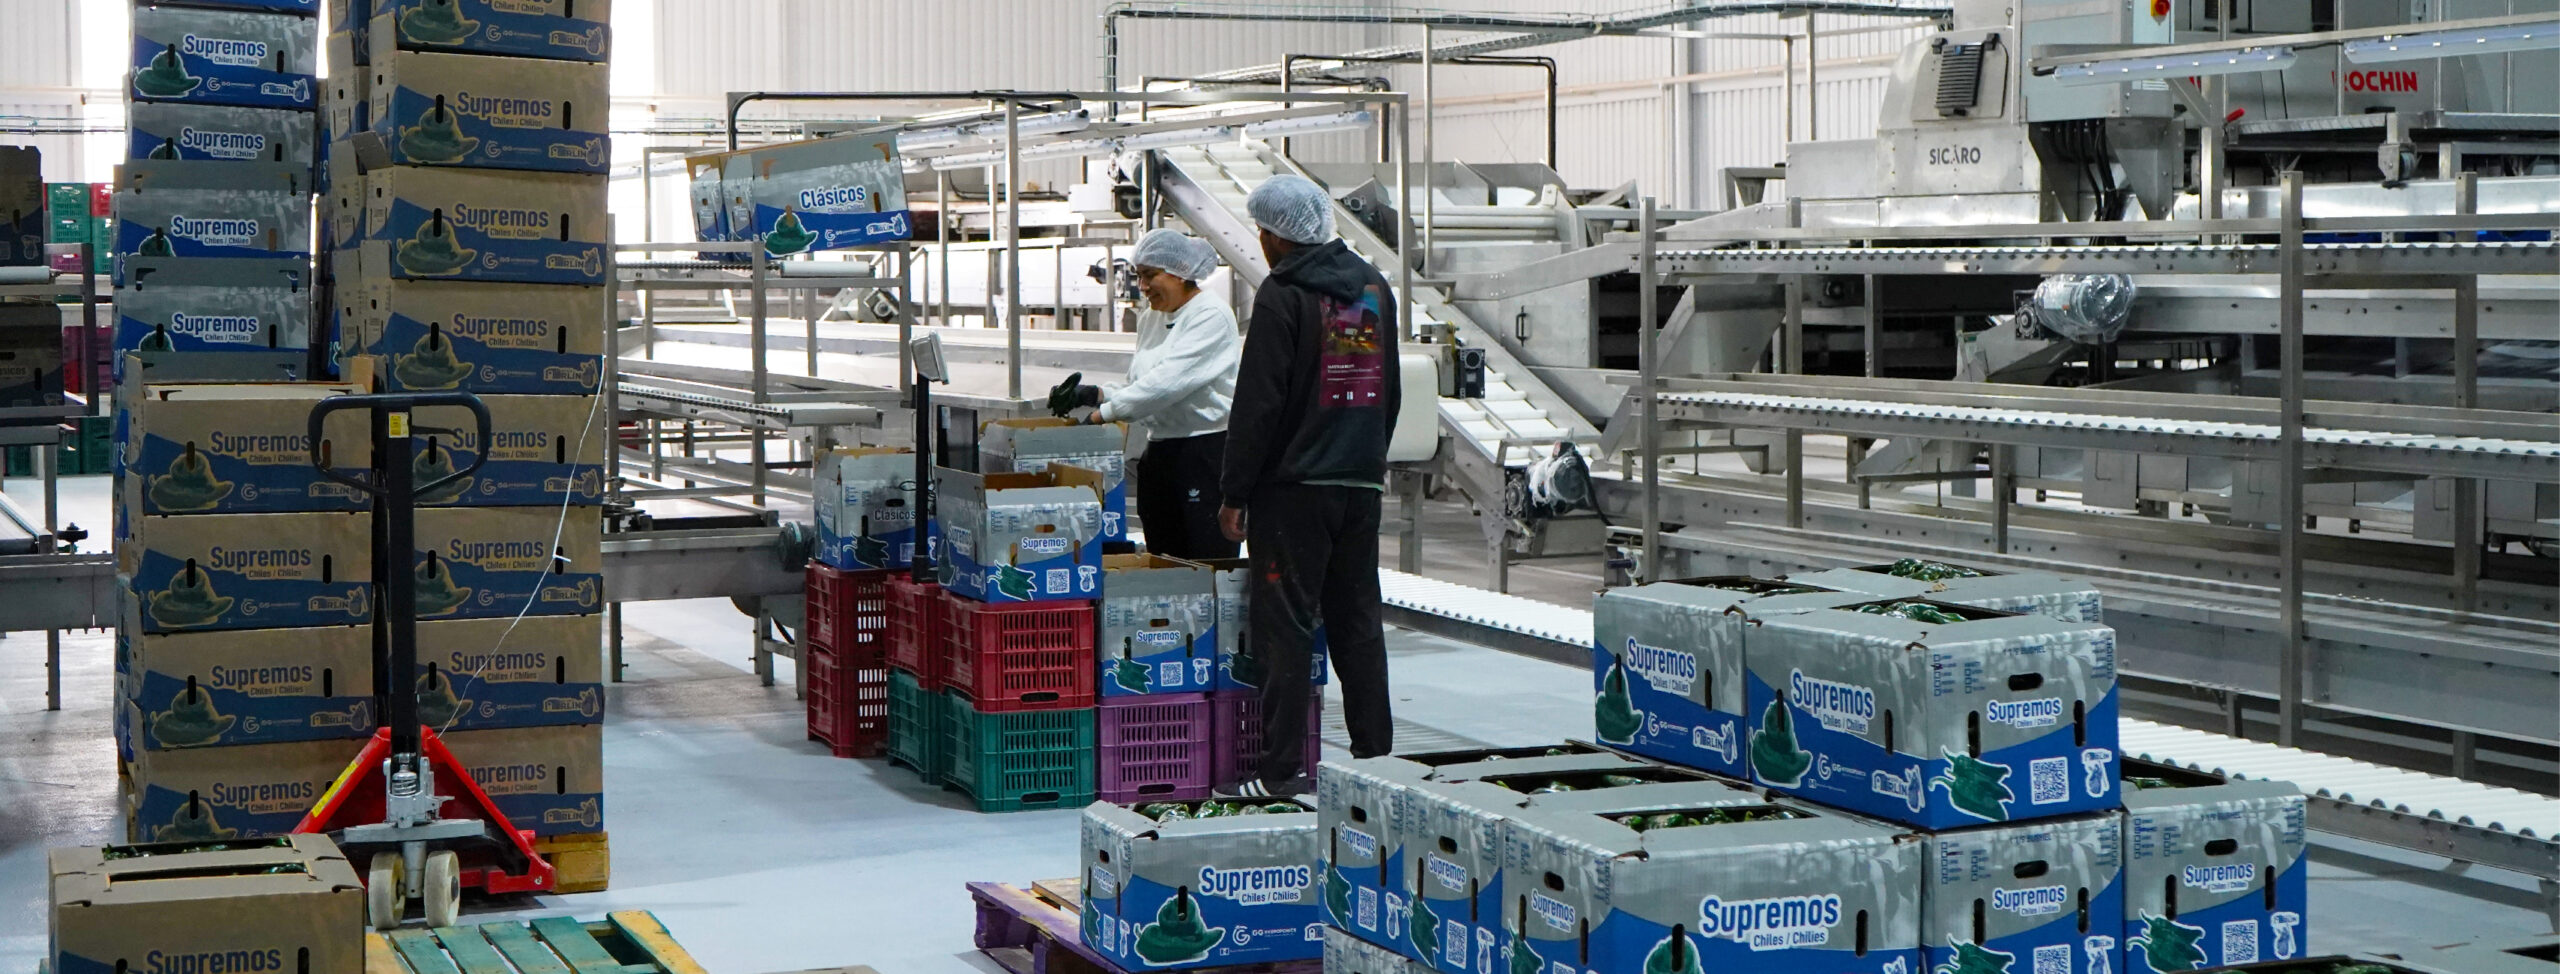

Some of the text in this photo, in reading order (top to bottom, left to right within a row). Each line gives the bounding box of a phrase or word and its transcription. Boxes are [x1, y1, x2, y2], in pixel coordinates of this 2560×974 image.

[185, 35, 266, 57] Supremos
[457, 92, 551, 117] Supremos
[182, 128, 263, 150] Supremos
[1929, 146, 1981, 165] SICARO
[801, 185, 866, 209] Clásicos
[172, 216, 257, 237] Supremos
[454, 203, 549, 231] Supremos
[172, 313, 257, 334] Supremos
[453, 313, 547, 340] Supremos
[211, 431, 313, 455] Supremos
[452, 428, 547, 450] Suremos
[450, 539, 544, 562] Supremos
[1022, 538, 1066, 550] Supremos
[211, 546, 312, 571] Supremos
[1137, 630, 1180, 643] Supremos
[451, 651, 546, 675] Supremos
[1629, 638, 1695, 679] Supremos
[212, 665, 313, 690] Supremos
[1653, 676, 1668, 689] Chiles
[1792, 672, 1874, 718] Supremos
[1823, 714, 1841, 728] Chiles
[1988, 699, 2061, 723] Supremos
[466, 763, 546, 784] upremos
[212, 781, 313, 803] Supremos
[1341, 823, 1376, 851] Supremos
[1429, 853, 1466, 883] Supremos
[2185, 863, 2253, 886] Supremos
[1201, 867, 1309, 896] Supremos
[1242, 893, 1266, 903] Chiles
[1272, 891, 1299, 901] Chilies
[1532, 890, 1575, 923] Supremos
[1994, 887, 2065, 910] Supremos
[1702, 897, 1839, 939] Supremos
[1753, 933, 1784, 947] Chiles
[1792, 930, 1825, 945] Chilies
[146, 949, 282, 974] Supremos
